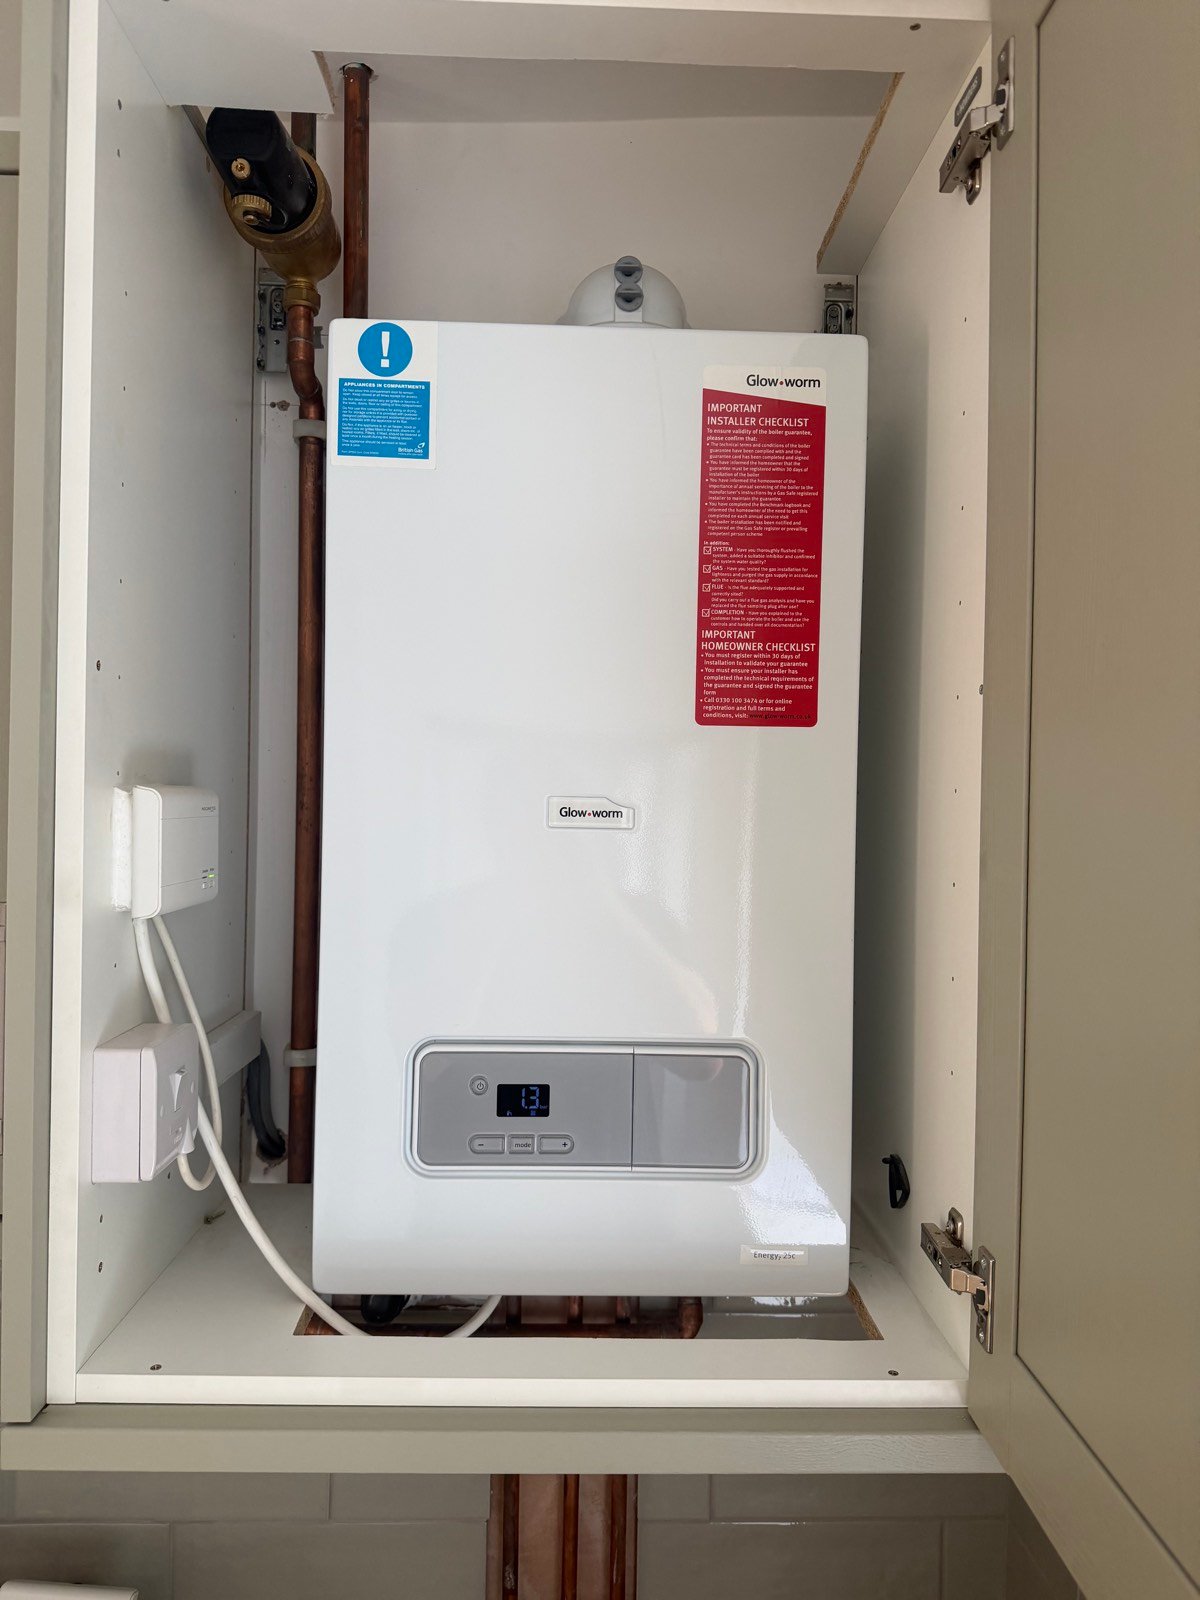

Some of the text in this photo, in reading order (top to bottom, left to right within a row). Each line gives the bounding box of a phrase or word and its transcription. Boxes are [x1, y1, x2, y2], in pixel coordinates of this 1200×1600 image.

[708, 404, 762, 412] IMPORTANT
[708, 417, 809, 426] INSTALLER CHECKLIST
[702, 630, 755, 638] IMPORTANT
[702, 642, 816, 651] HOMEOWNER CHECKLIST
[522, 1087, 539, 1109] 1.3
[754, 1251, 781, 1260] Energy,
